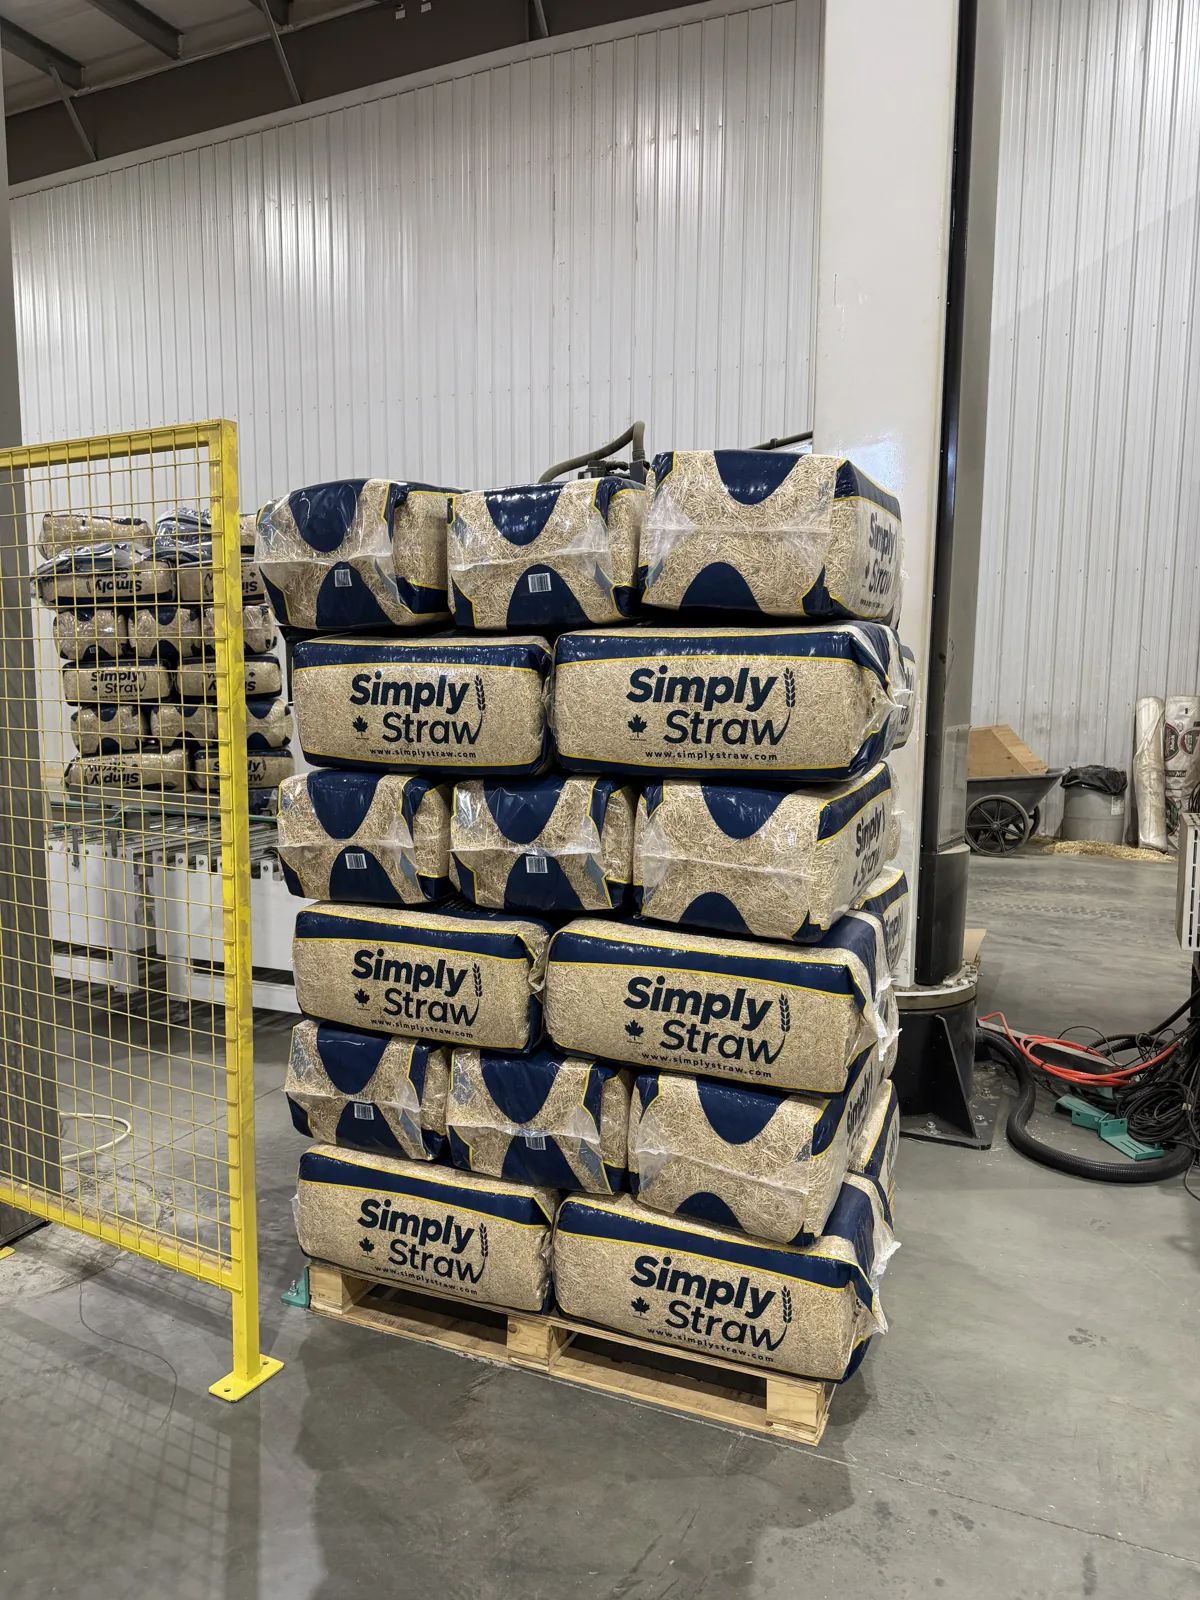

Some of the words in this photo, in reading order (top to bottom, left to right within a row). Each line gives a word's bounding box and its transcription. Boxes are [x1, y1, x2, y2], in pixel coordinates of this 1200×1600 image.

[90, 670, 140, 682] Simply
[104, 682, 146, 694] Straw
[350, 670, 470, 715] Simply
[626, 664, 779, 712] Simply
[381, 711, 483, 745] Straw
[662, 709, 790, 746] Straw
[369, 747, 477, 759] www.simplystraw.com
[644, 750, 778, 761] www.simplystraw.com
[351, 948, 469, 998] Simply
[383, 987, 480, 1027] Straw
[623, 975, 774, 1032] Simply
[370, 1019, 474, 1039] www.simplystraw.com
[660, 1019, 786, 1065] Straw
[641, 1052, 772, 1079] www.simplystraw.com
[357, 1198, 475, 1255] Simply
[374, 1265, 478, 1296] www.simplystraw.com
[388, 1238, 486, 1285] Straw
[630, 1255, 776, 1320] Simply
[646, 1327, 774, 1363] www.simplystraw.com
[665, 1300, 788, 1352] Straw
